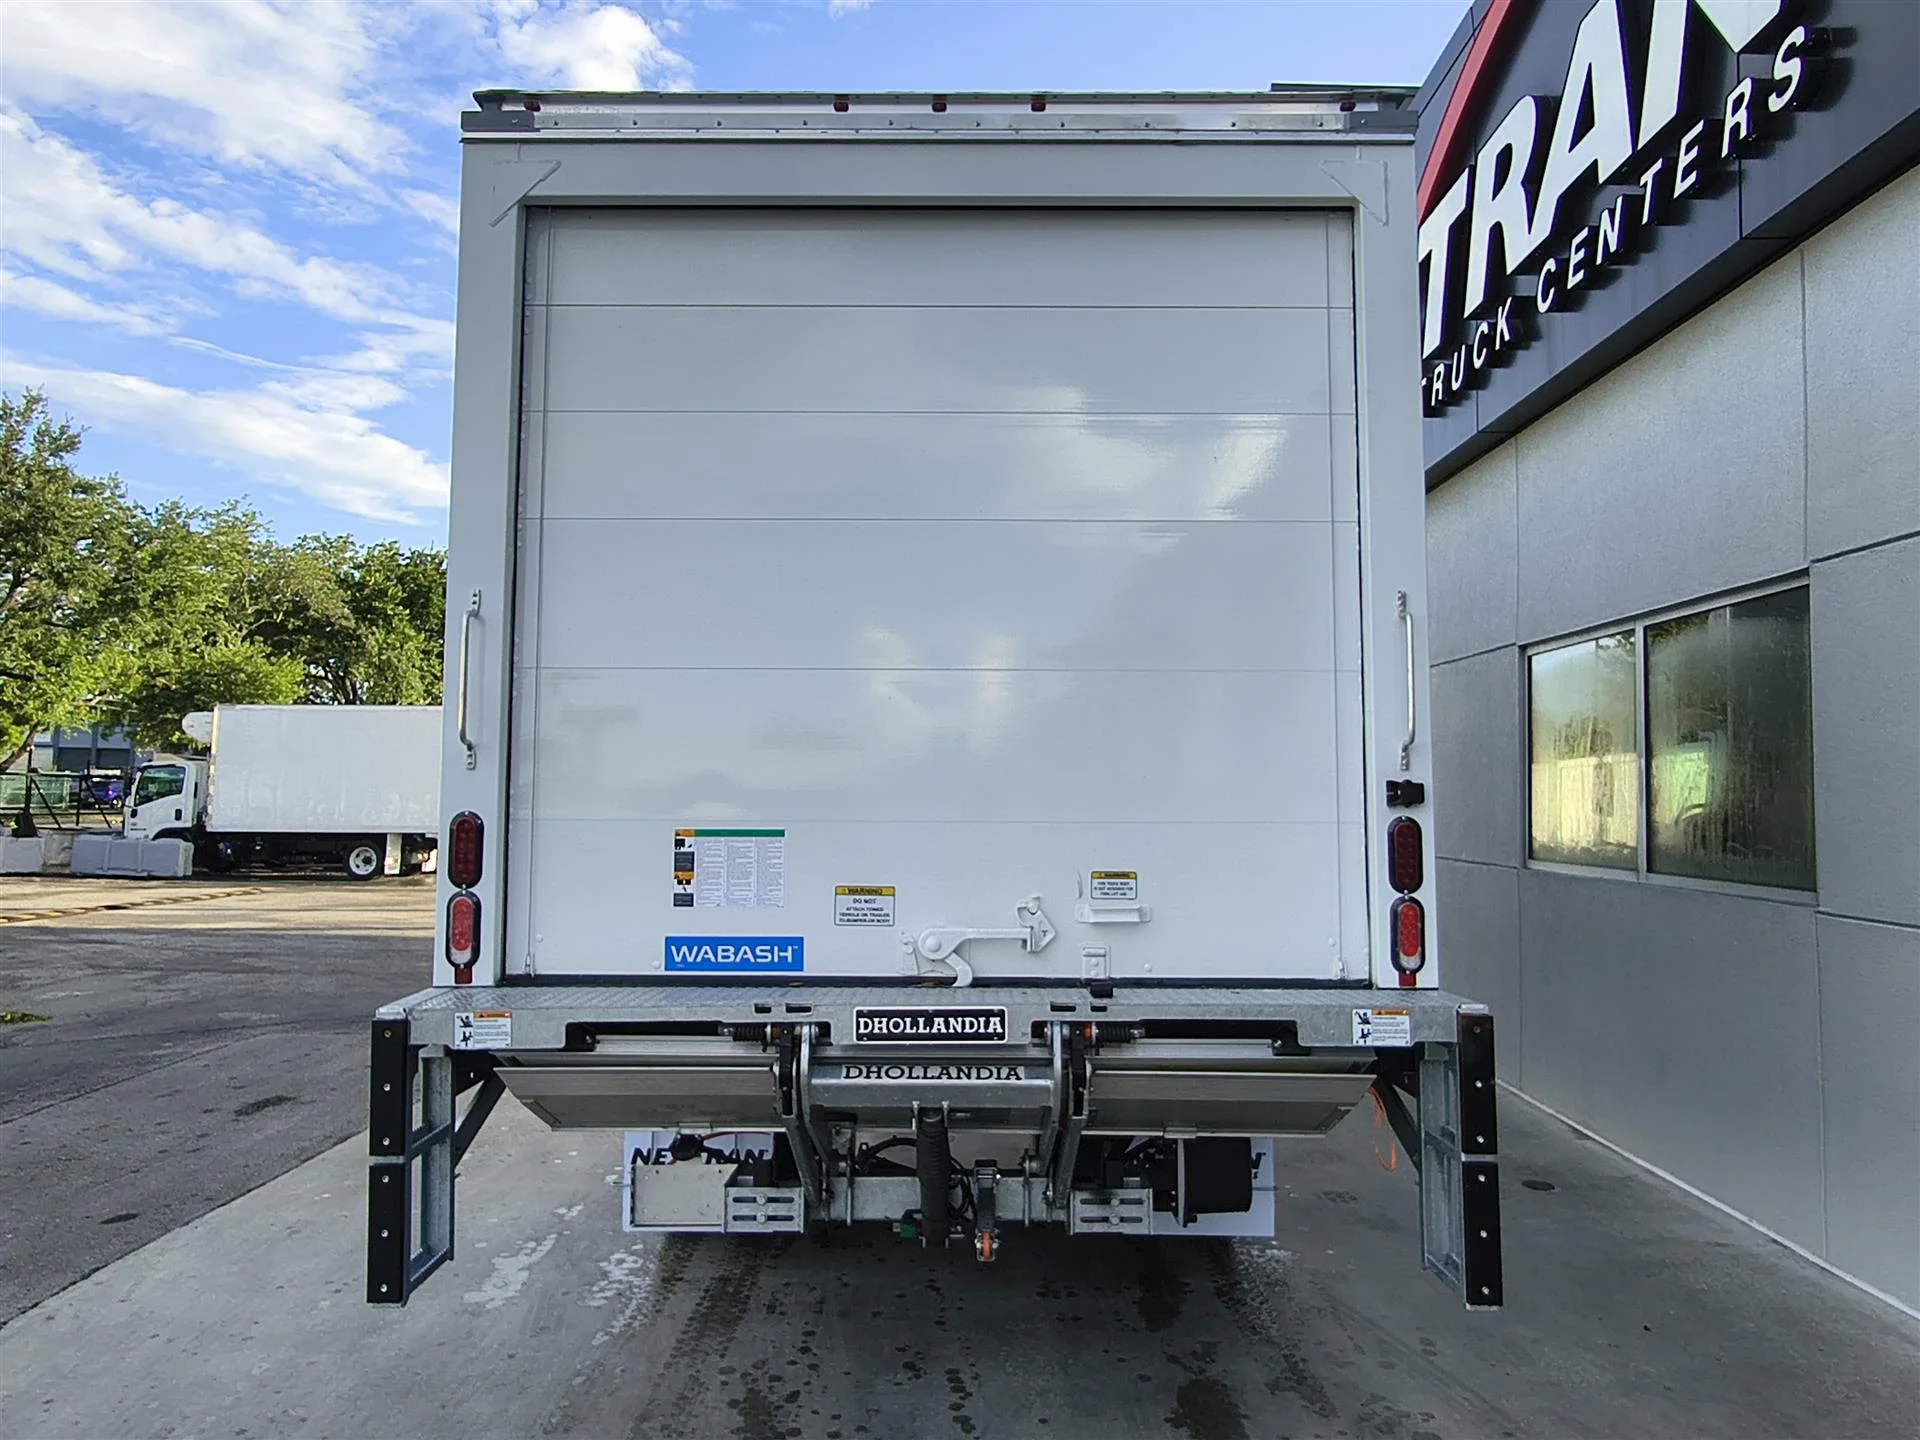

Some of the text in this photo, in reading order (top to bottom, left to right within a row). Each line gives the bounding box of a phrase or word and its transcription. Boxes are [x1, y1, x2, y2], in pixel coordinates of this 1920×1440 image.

[1421, 25, 1807, 406] RUCK CENTERS
[670, 945, 792, 963] WABASH
[858, 1017, 1003, 1034] DHOLLANDIA
[843, 1065, 1023, 1081] DHOLLANDIA
